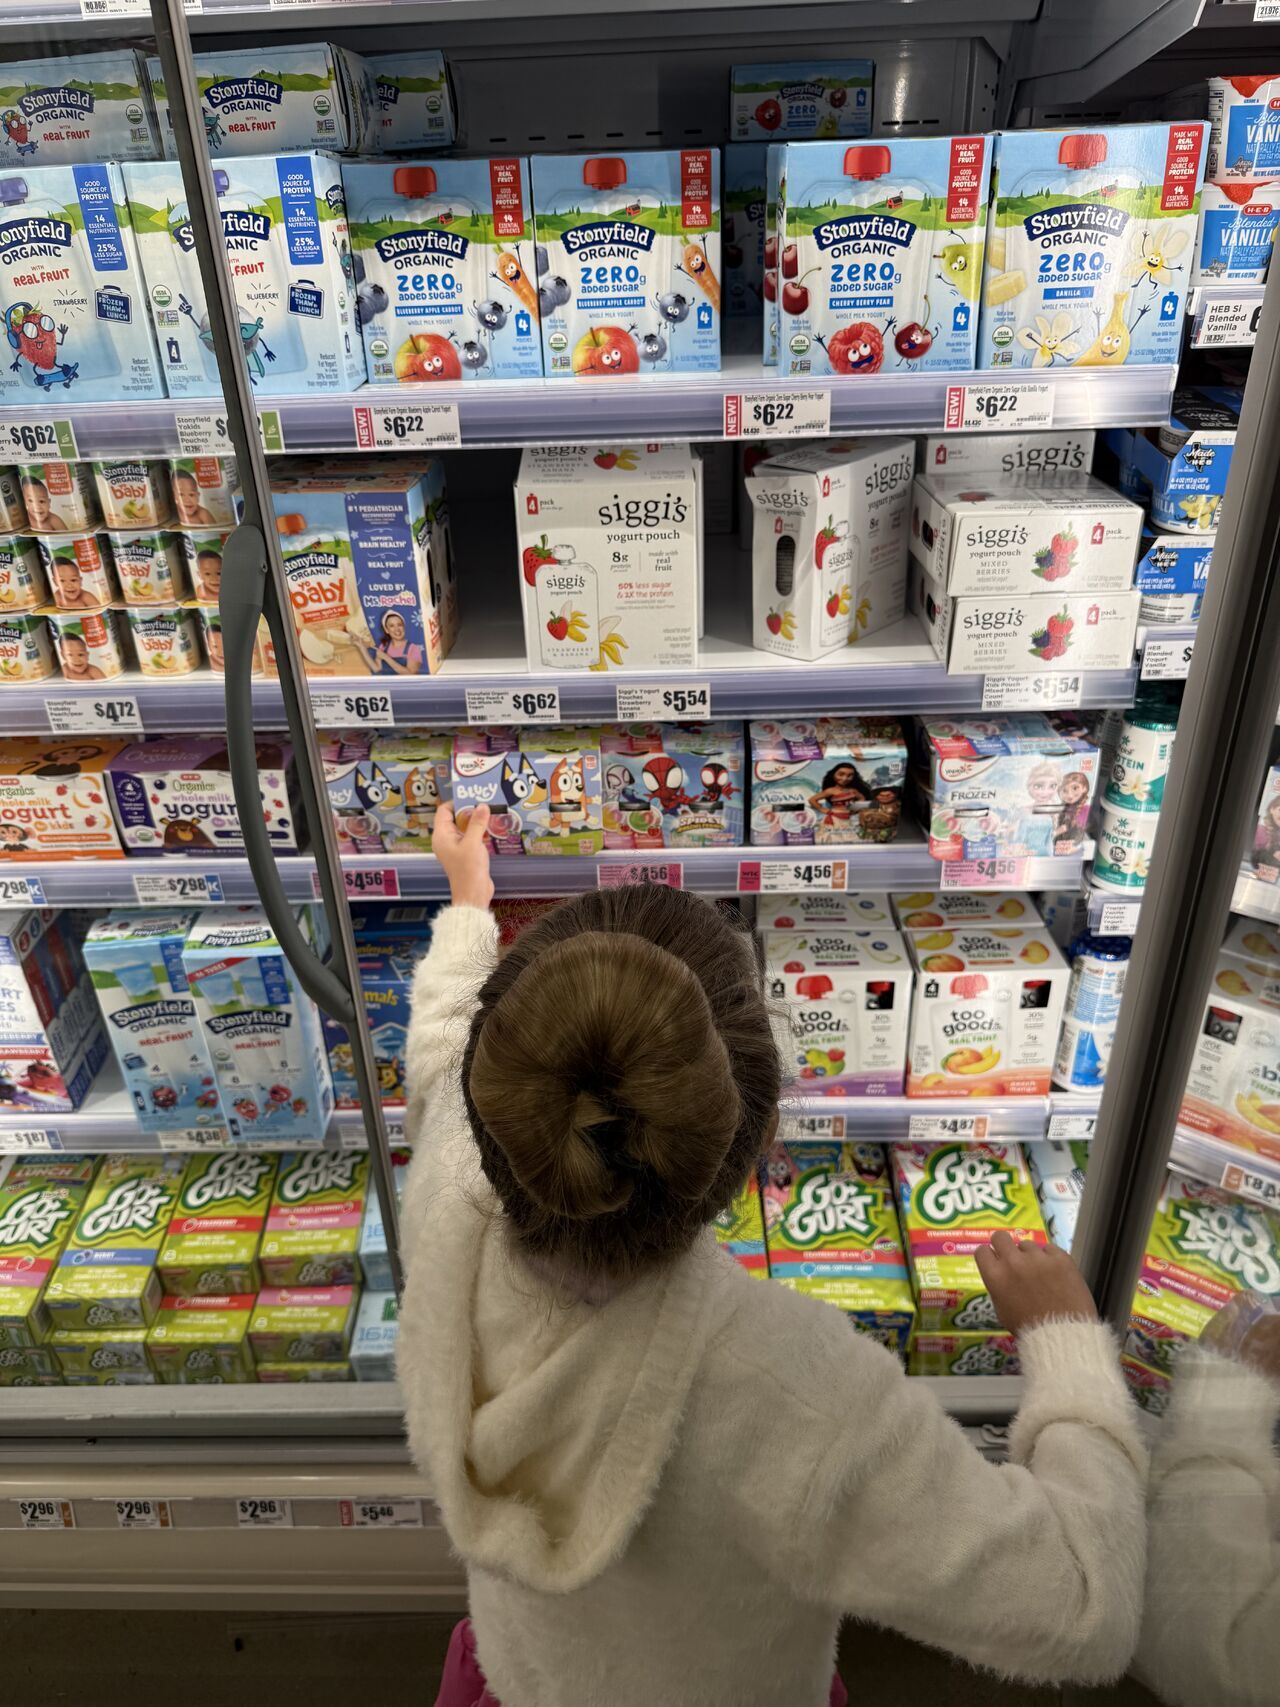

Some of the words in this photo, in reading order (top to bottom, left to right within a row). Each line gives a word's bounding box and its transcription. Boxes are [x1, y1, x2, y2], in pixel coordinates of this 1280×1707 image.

[210, 80, 278, 104] Stonyfield
[23, 90, 90, 110] Stonyfield
[222, 101, 272, 115] ORGANIC
[36, 108, 85, 123] ORGANIC
[1168, 168, 1194, 176] PROTEIN
[1174, 185, 1184, 193] 14
[81, 193, 109, 201] PROTEIN
[958, 198, 969, 206] 14
[1031, 206, 1124, 235] Stonyfield
[1229, 217, 1273, 230] Blended
[566, 223, 649, 249] Stonyfield
[820, 217, 909, 244] Stonyfield
[381, 233, 463, 257] Stonyfield
[1041, 232, 1108, 249] ORGANIC
[2, 245, 61, 265] ORGANIC
[579, 247, 639, 261] ORGANIC
[831, 243, 896, 259] ORGANIC
[235, 262, 264, 276] FRUIT
[394, 255, 454, 270] ORGANIC
[99, 297, 124, 306] FROZEN
[247, 292, 279, 300] BLUEBERRY
[292, 292, 316, 301] FROZEN
[295, 299, 313, 307] THAW
[832, 299, 854, 307] CHERRY
[106, 312, 128, 320] LUNCH
[1211, 305, 1230, 313] HEB
[1209, 314, 1247, 322] Blended
[949, 391, 960, 425] NEW!
[177, 416, 211, 424] Stonyfield
[728, 400, 736, 433] NEW!
[180, 430, 211, 438] Blueberry
[360, 413, 370, 446] NEW!
[103, 465, 148, 479] Stonyfield
[865, 455, 912, 495] siggi's
[110, 477, 144, 485] ORGANIC
[111, 484, 146, 500] baby
[756, 489, 808, 508] siggi's
[599, 493, 688, 528] siggi's
[607, 532, 643, 543] yogurt
[646, 530, 680, 542] pouch
[967, 524, 1028, 548] siggi's
[969, 551, 995, 559] yogurt
[997, 549, 1021, 557] pouch
[655, 564, 672, 572] fruit
[291, 569, 332, 582] ORGANIC
[546, 576, 585, 589] siggi's
[651, 582, 671, 590] sugar
[380, 596, 416, 606] Rachel
[963, 608, 1024, 630] siggi's
[967, 632, 993, 640] yogurt
[173, 780, 215, 792] Organics
[25, 798, 50, 806] milk
[951, 790, 996, 800] FROZEN
[2, 803, 72, 823] ogurt
[49, 821, 74, 830] kids
[1102, 832, 1145, 849] PROTEIN
[810, 945, 851, 953] good
[958, 943, 1003, 953] good
[113, 1002, 193, 1024] Stonyfield
[800, 1011, 832, 1022] too
[952, 1010, 985, 1022] too
[130, 1017, 188, 1032] ORGANIC
[210, 1014, 287, 1032] Stonyfield
[793, 1020, 841, 1038] good
[943, 1018, 994, 1037] good
[225, 1026, 282, 1040] ORGANIC
[15, 1167, 72, 1177] LUNCH
[282, 1155, 363, 1199] GURT
[185, 1164, 271, 1207] GURT
[922, 1170, 1009, 1222] GURT
[82, 1195, 170, 1238] GURT
[785, 1195, 873, 1240] GURT
